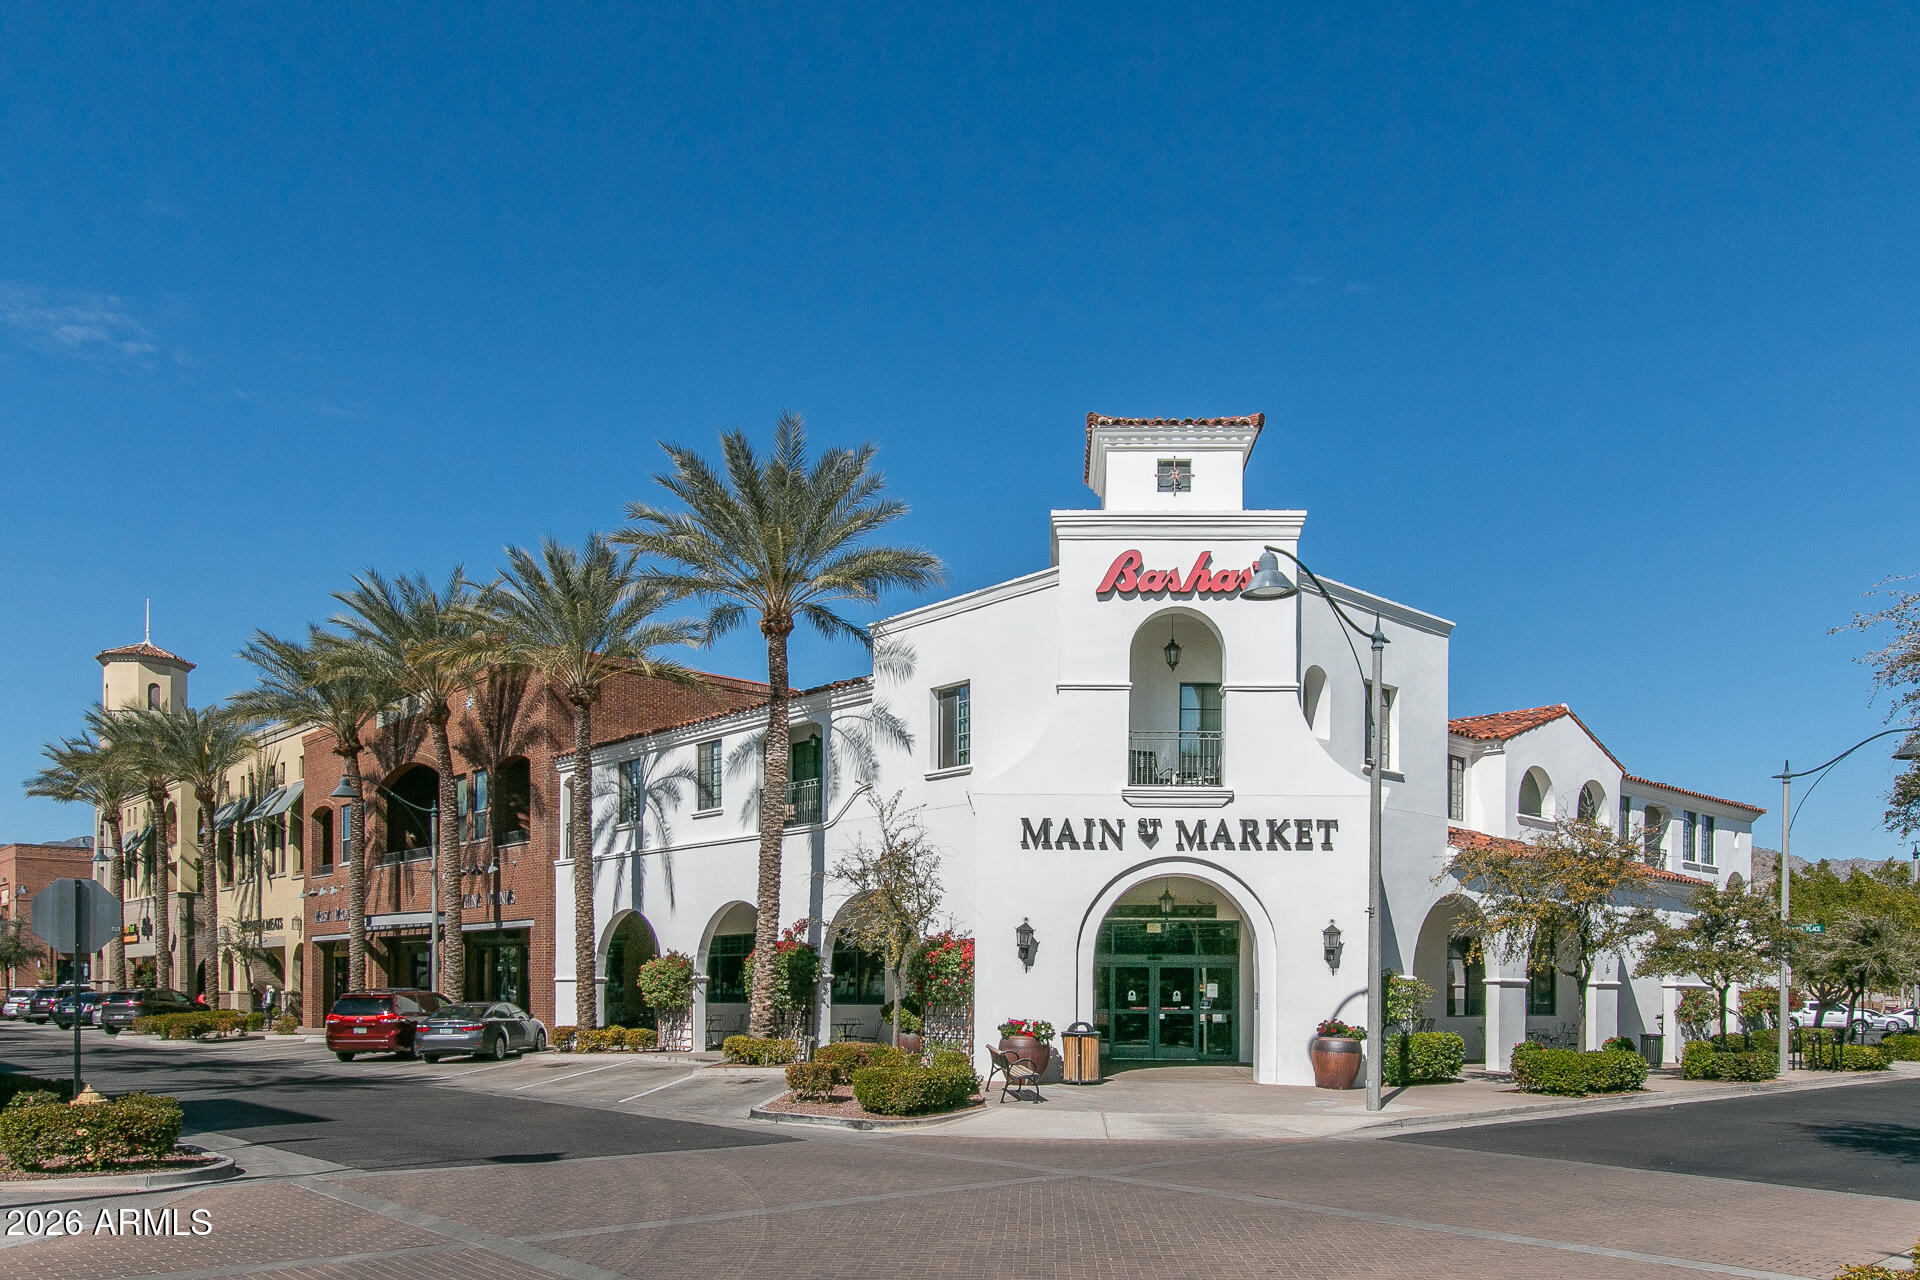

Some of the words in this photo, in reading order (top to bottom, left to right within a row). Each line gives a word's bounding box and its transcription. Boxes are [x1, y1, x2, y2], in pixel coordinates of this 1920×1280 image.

[1020, 818, 1126, 850] MAIN
[1175, 819, 1339, 851] MARKET
[266, 917, 283, 931] MEATS
